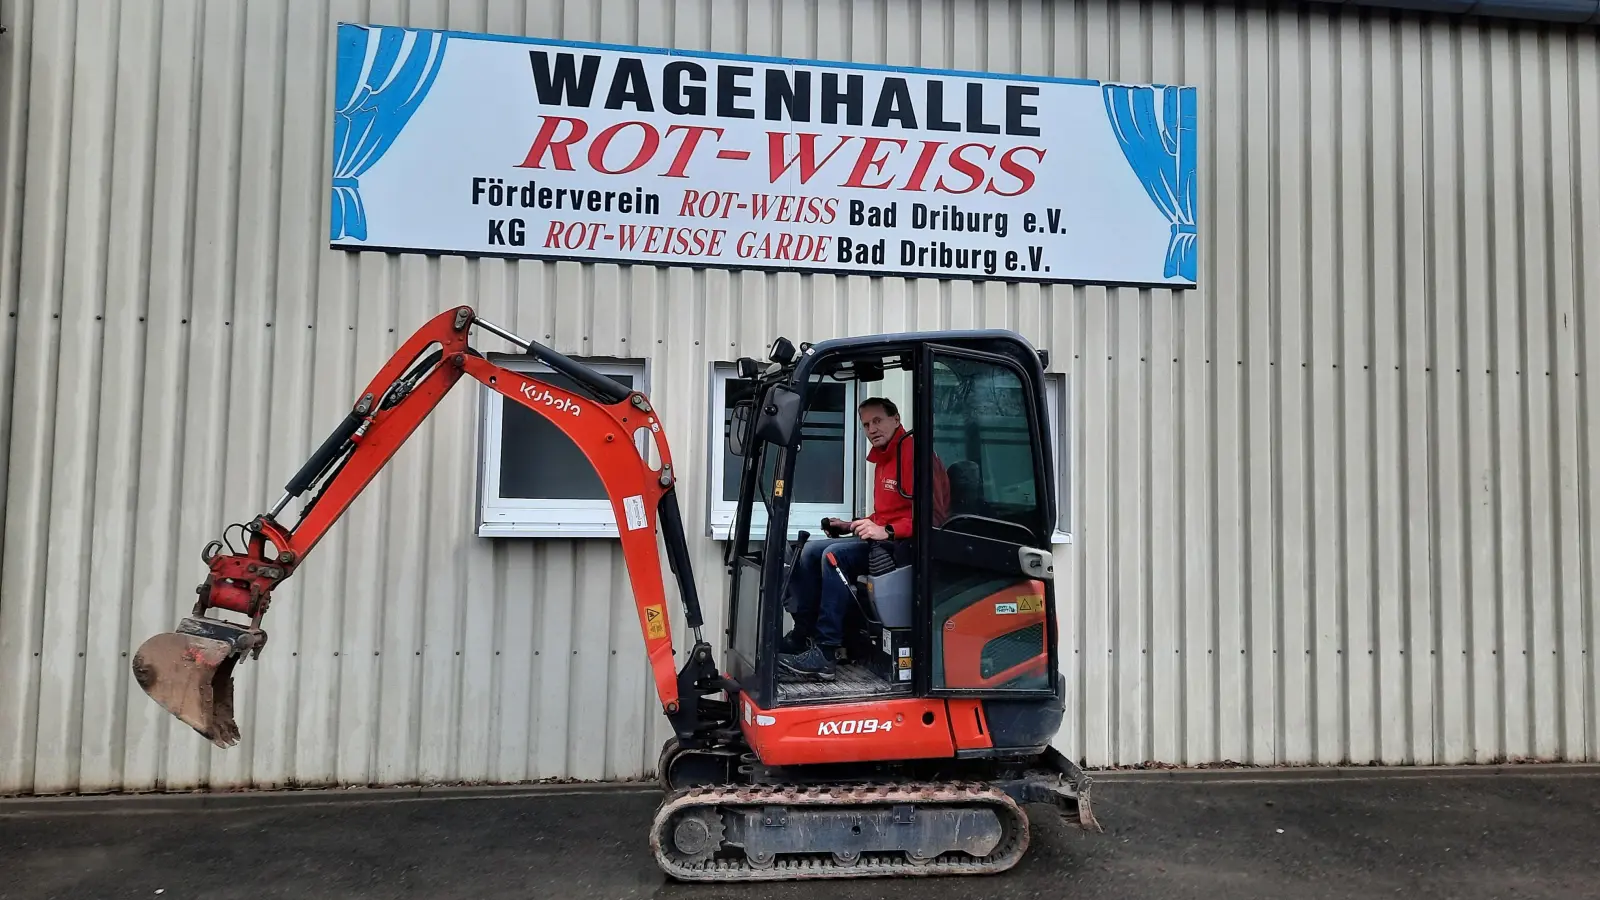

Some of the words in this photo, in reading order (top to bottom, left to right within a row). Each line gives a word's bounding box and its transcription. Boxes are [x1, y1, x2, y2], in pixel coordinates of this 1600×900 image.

[529, 50, 1041, 137] WAGENHALLE
[513, 115, 1047, 197] ROT-WEISS
[472, 177, 660, 215] Förderverein
[677, 189, 839, 225] ROT-WEISS
[849, 199, 897, 228] Bad
[912, 202, 1008, 238] Driburg
[1023, 208, 1067, 235] e.V.
[488, 218, 526, 247] KG
[543, 220, 727, 257] ROT-WEISSE
[736, 230, 832, 263] GARDE
[837, 236, 885, 265] Bad
[900, 239, 997, 275] Driburg
[1004, 245, 1050, 273] e.V.
[519, 382, 581, 417] Kubota
[817, 719, 893, 736] KX019-4
